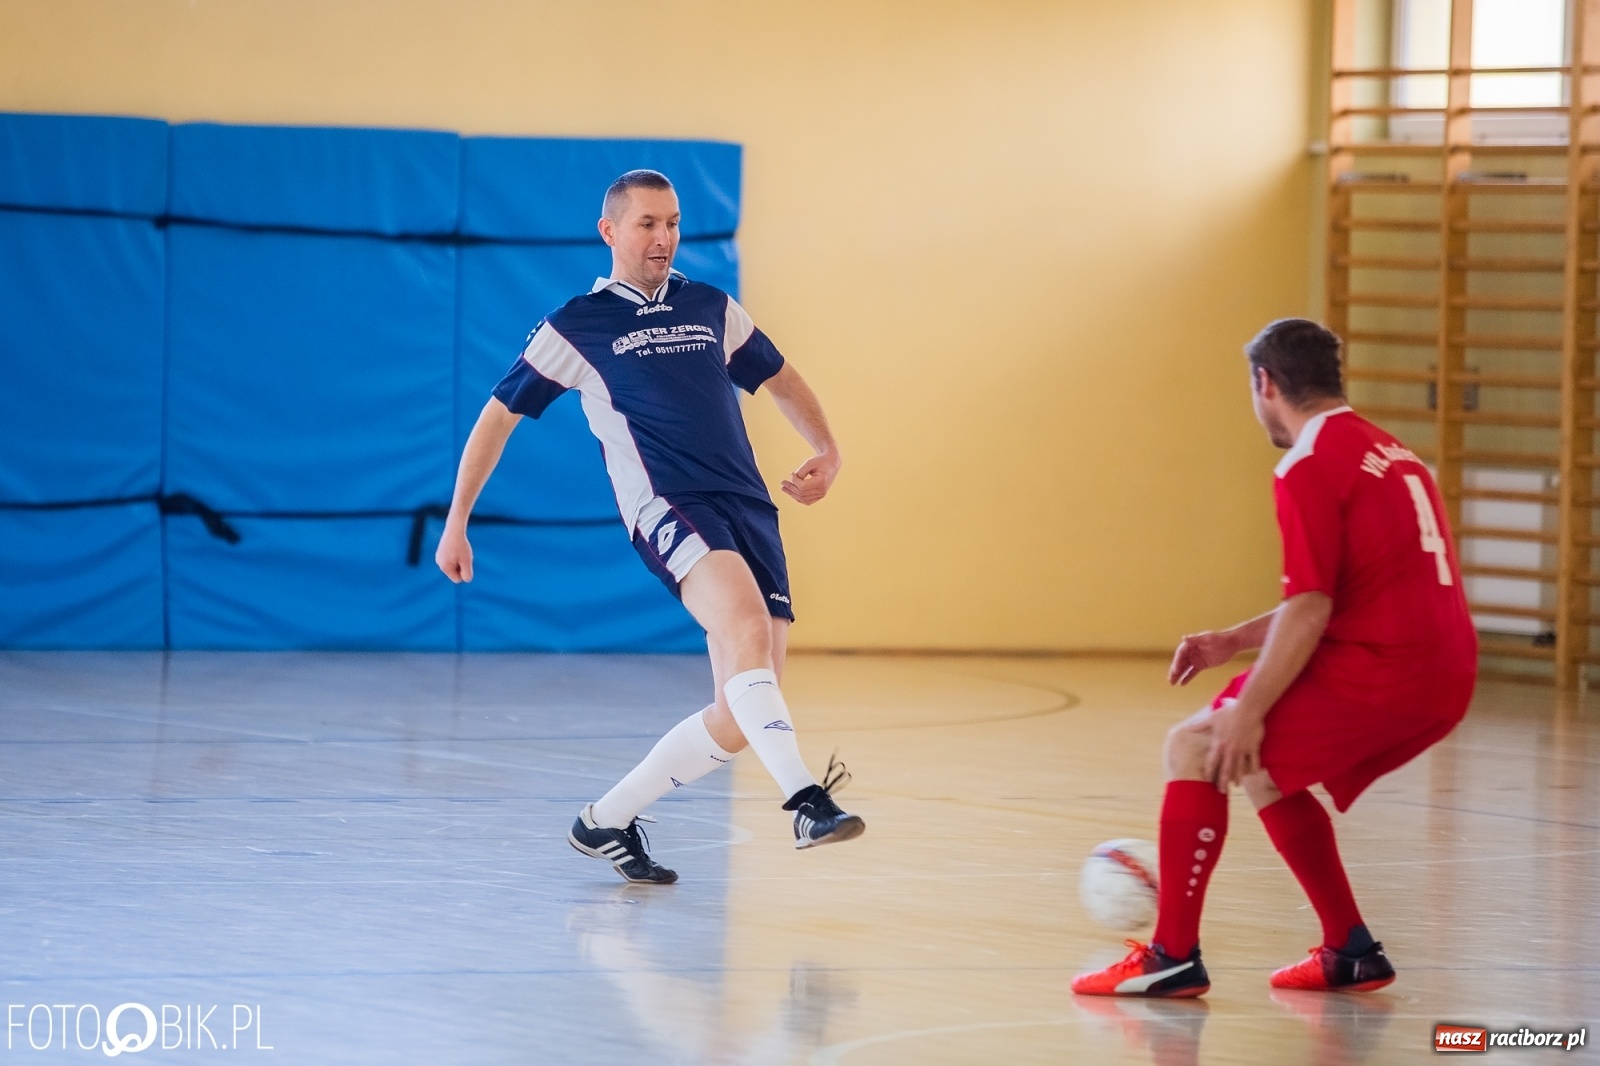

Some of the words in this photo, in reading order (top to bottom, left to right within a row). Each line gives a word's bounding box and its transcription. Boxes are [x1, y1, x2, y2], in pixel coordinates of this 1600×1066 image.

[643, 303, 673, 315] lotto
[627, 327, 668, 341] PETER
[635, 347, 654, 358] Tel.
[655, 342, 707, 355] 0511/777777
[1403, 474, 1453, 586] 4
